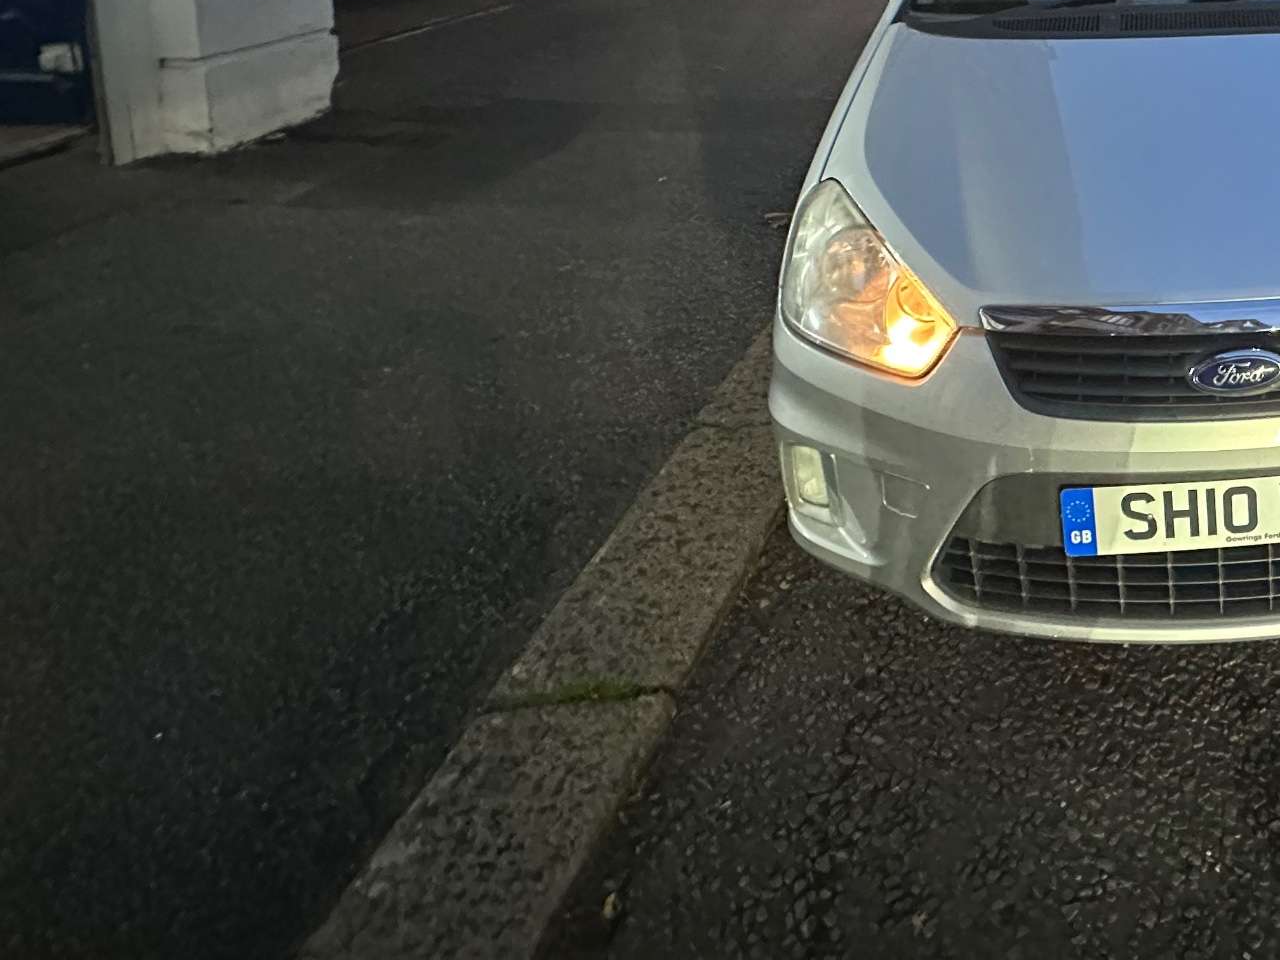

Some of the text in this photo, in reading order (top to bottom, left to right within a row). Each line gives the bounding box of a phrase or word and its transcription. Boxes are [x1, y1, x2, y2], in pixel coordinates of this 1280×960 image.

[1213, 361, 1275, 386] Ford
[1120, 485, 1259, 541] SH10
[1070, 529, 1092, 545] GB
